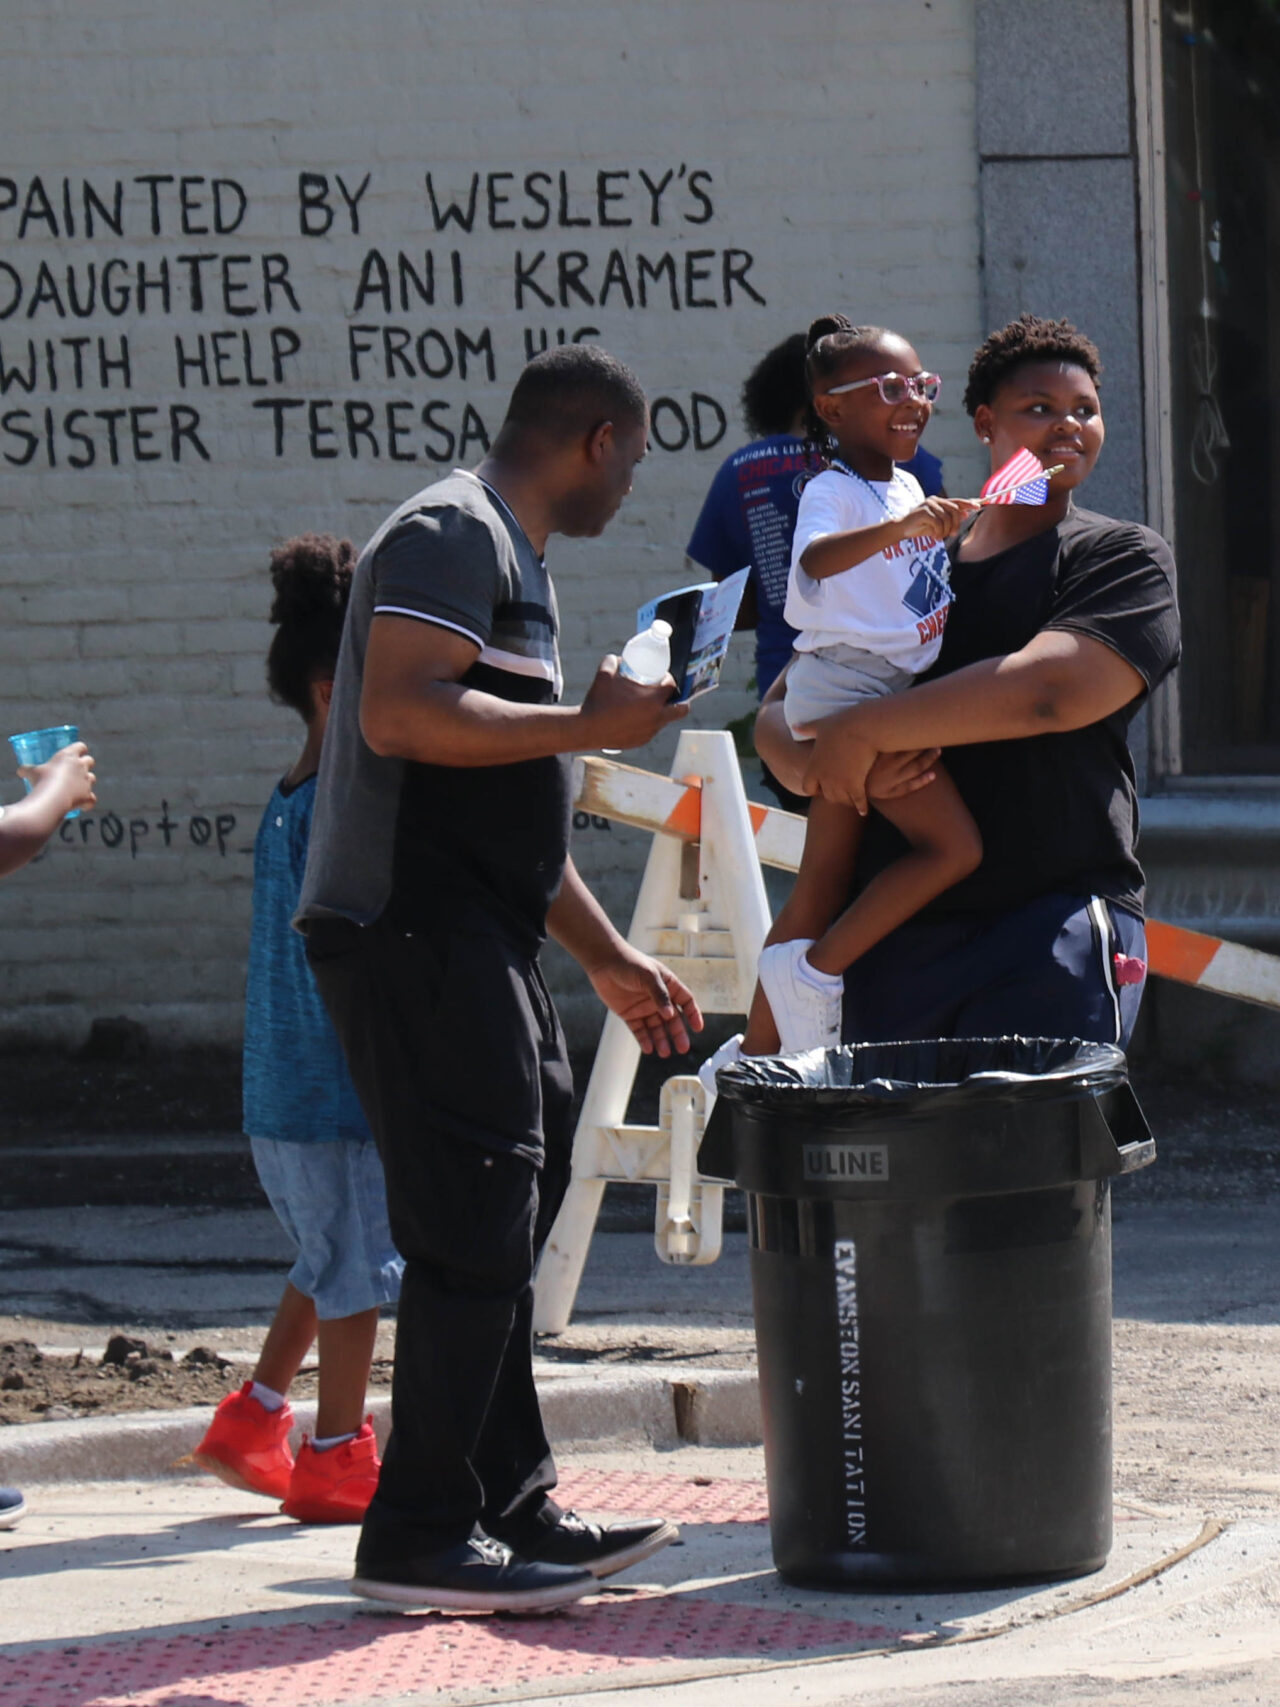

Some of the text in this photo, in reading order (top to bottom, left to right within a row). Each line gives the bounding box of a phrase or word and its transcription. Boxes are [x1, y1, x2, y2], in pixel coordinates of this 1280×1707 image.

[300, 172, 371, 237] BY
[426, 163, 714, 234] WESLEY'S
[353, 249, 464, 313] ANI
[514, 249, 766, 309] KRAMER
[0, 334, 131, 394] WITH
[174, 327, 301, 388] HELP
[348, 325, 496, 381] FROM
[1, 404, 210, 468] SISTER
[253, 398, 490, 461] TERESA
[808, 1151, 883, 1175] ULINE
[834, 1240, 867, 1545] EVANSTON SANITATION
